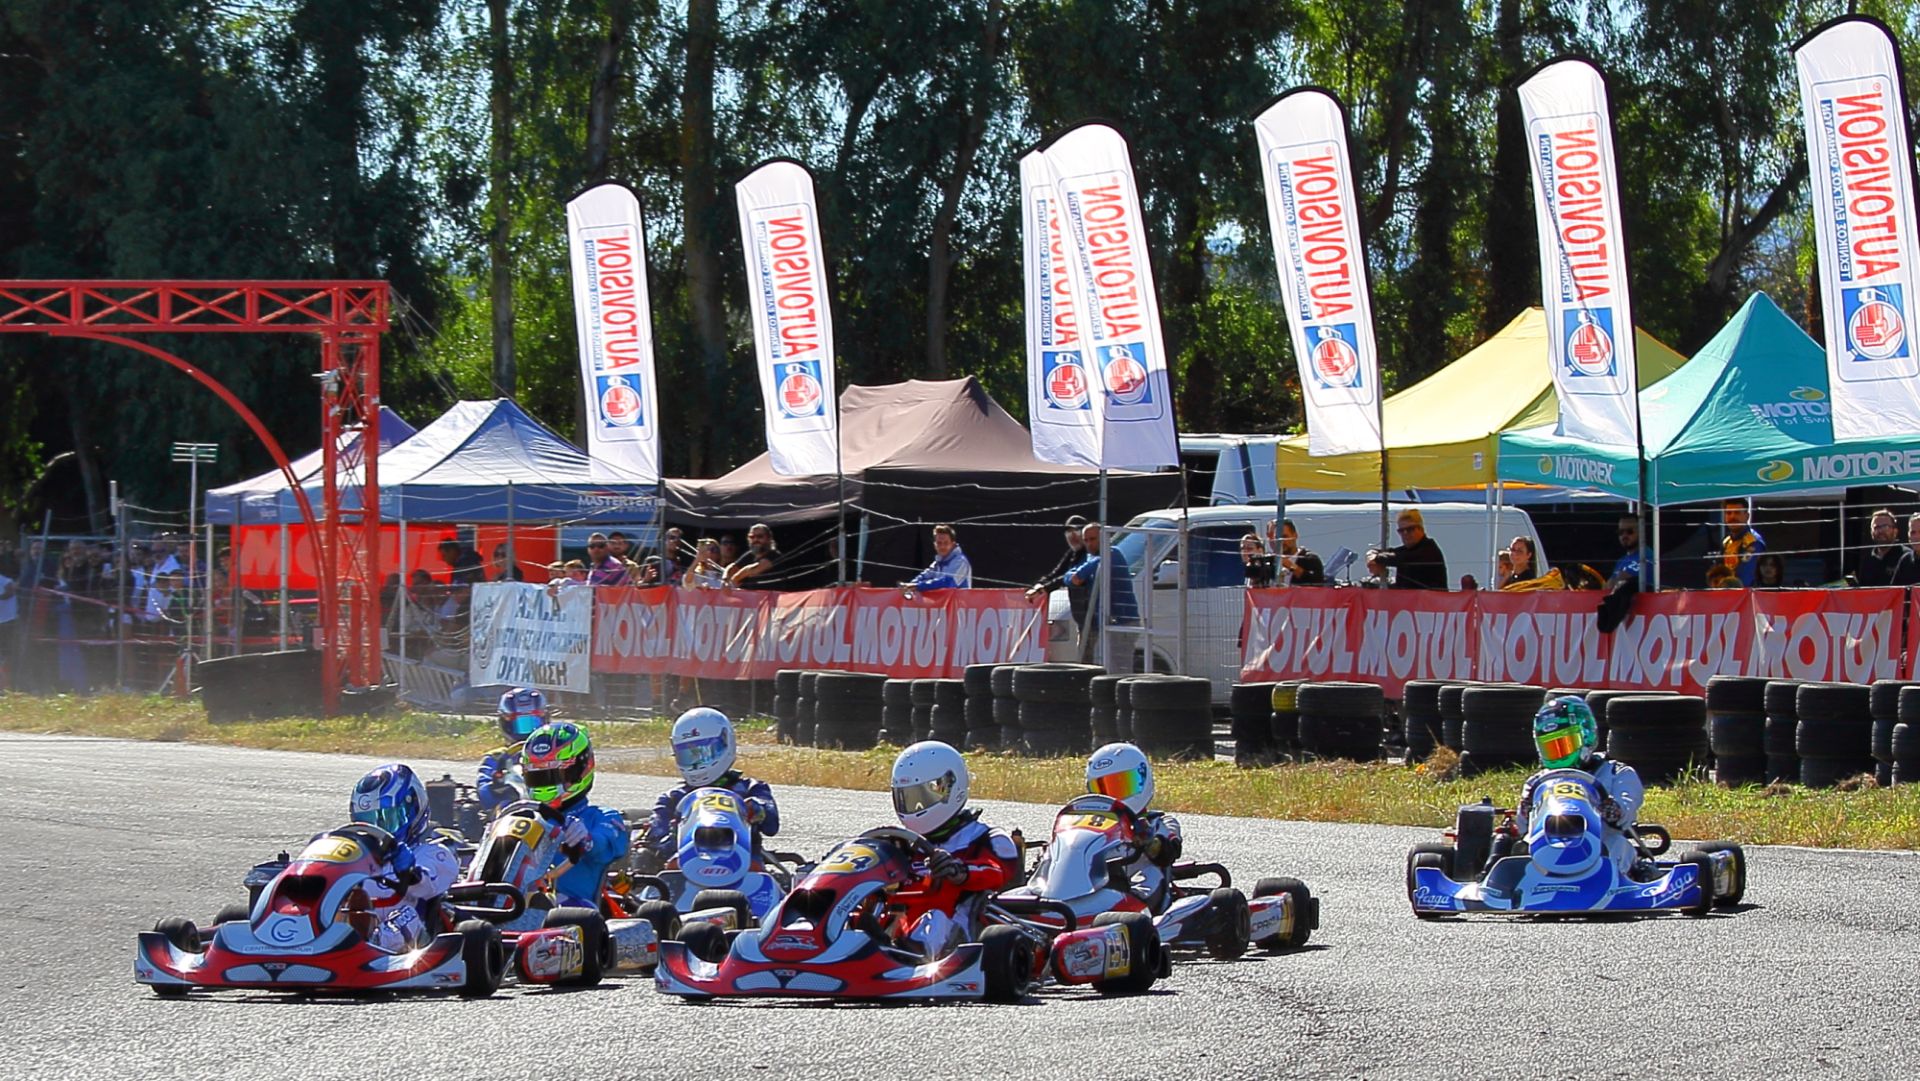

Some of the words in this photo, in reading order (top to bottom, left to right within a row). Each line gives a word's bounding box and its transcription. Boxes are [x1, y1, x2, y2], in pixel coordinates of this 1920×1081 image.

[1784, 417, 1799, 425] of
[1555, 455, 1613, 485] MOTOREX
[952, 606, 1046, 668] MOTUL
[1358, 608, 1473, 680] MOTUL
[1479, 611, 1606, 686] MOTUL
[1609, 611, 1742, 688] MOTUL
[1746, 608, 1898, 685] MOTUL
